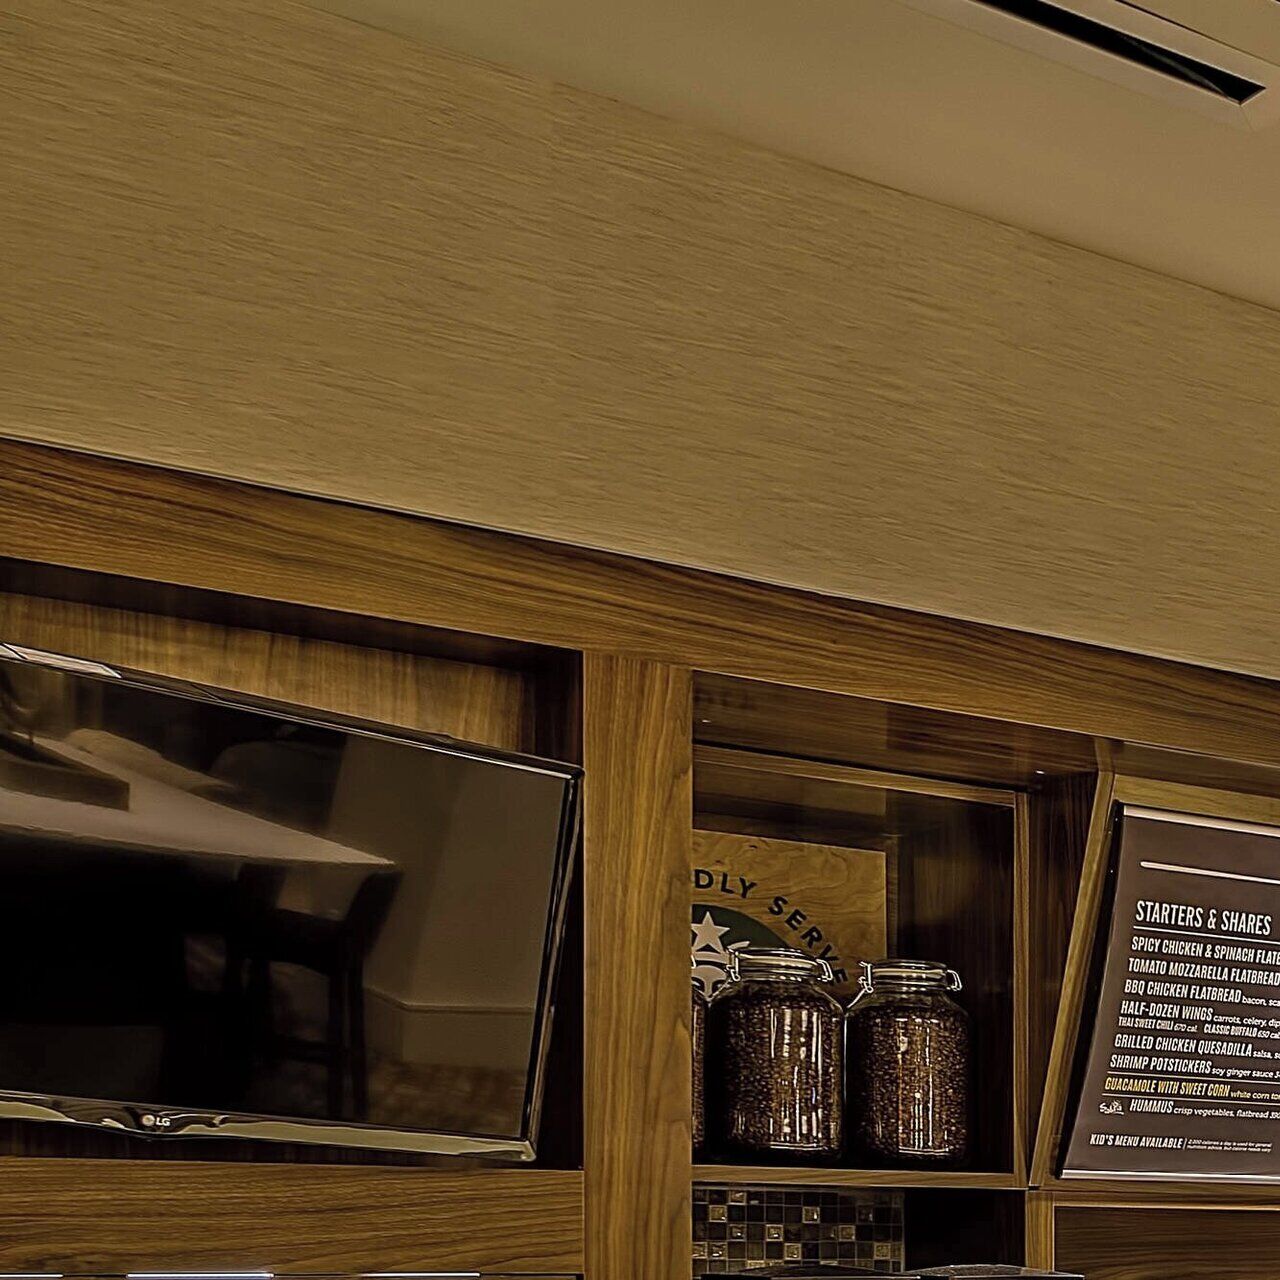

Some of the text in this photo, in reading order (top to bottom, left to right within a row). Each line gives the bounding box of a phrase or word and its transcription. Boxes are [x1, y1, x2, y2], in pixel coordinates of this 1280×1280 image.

[1135, 900, 1271, 935] STARTERS & SHARES
[1131, 936, 1161, 952] SPICY
[1161, 939, 1203, 957] CHICKEN
[1204, 944, 1212, 958] &
[1213, 945, 1254, 962] SPINACH
[1128, 957, 1167, 975] TOMATO
[1168, 961, 1228, 981] MOZZARELLA
[1230, 968, 1280, 986] FLATBREAD
[1124, 979, 1145, 995] BBQ
[1146, 982, 1188, 998] CHICKEN
[1189, 986, 1241, 1003] FLATBREAD
[1120, 1000, 1180, 1018] HALF-DOZEN
[1182, 1006, 1213, 1021] WINGS
[1118, 1016, 1134, 1027] THAI
[1133, 1018, 1156, 1029] SWEET
[1155, 1019, 1173, 1030] CHILI
[1203, 1023, 1230, 1035] CLASSIC
[1230, 1025, 1257, 1037] BUFFALO
[1114, 1034, 1153, 1049] GRILLED
[1155, 1037, 1196, 1053] CHICKEN
[1197, 1040, 1252, 1057] QUESADILLA
[1110, 1054, 1149, 1069] SHRIMP
[1149, 1057, 1212, 1074] POTSTICKERS
[1211, 1067, 1225, 1076] soy
[1226, 1067, 1251, 1077] ginger
[1251, 1070, 1273, 1078] sauce
[1104, 1077, 1157, 1092] GUACAMOLE
[1157, 1080, 1179, 1094] WITH
[1179, 1082, 1207, 1096] SWEET
[1207, 1084, 1230, 1097] CORN
[1129, 1098, 1173, 1113] HUMMUS
[1173, 1107, 1193, 1115] crisp
[155, 1116, 171, 1127] LG
[1089, 1133, 1114, 1145] KID'S
[1114, 1134, 1139, 1146] MENU
[1139, 1136, 1184, 1148] AVAILABLE
